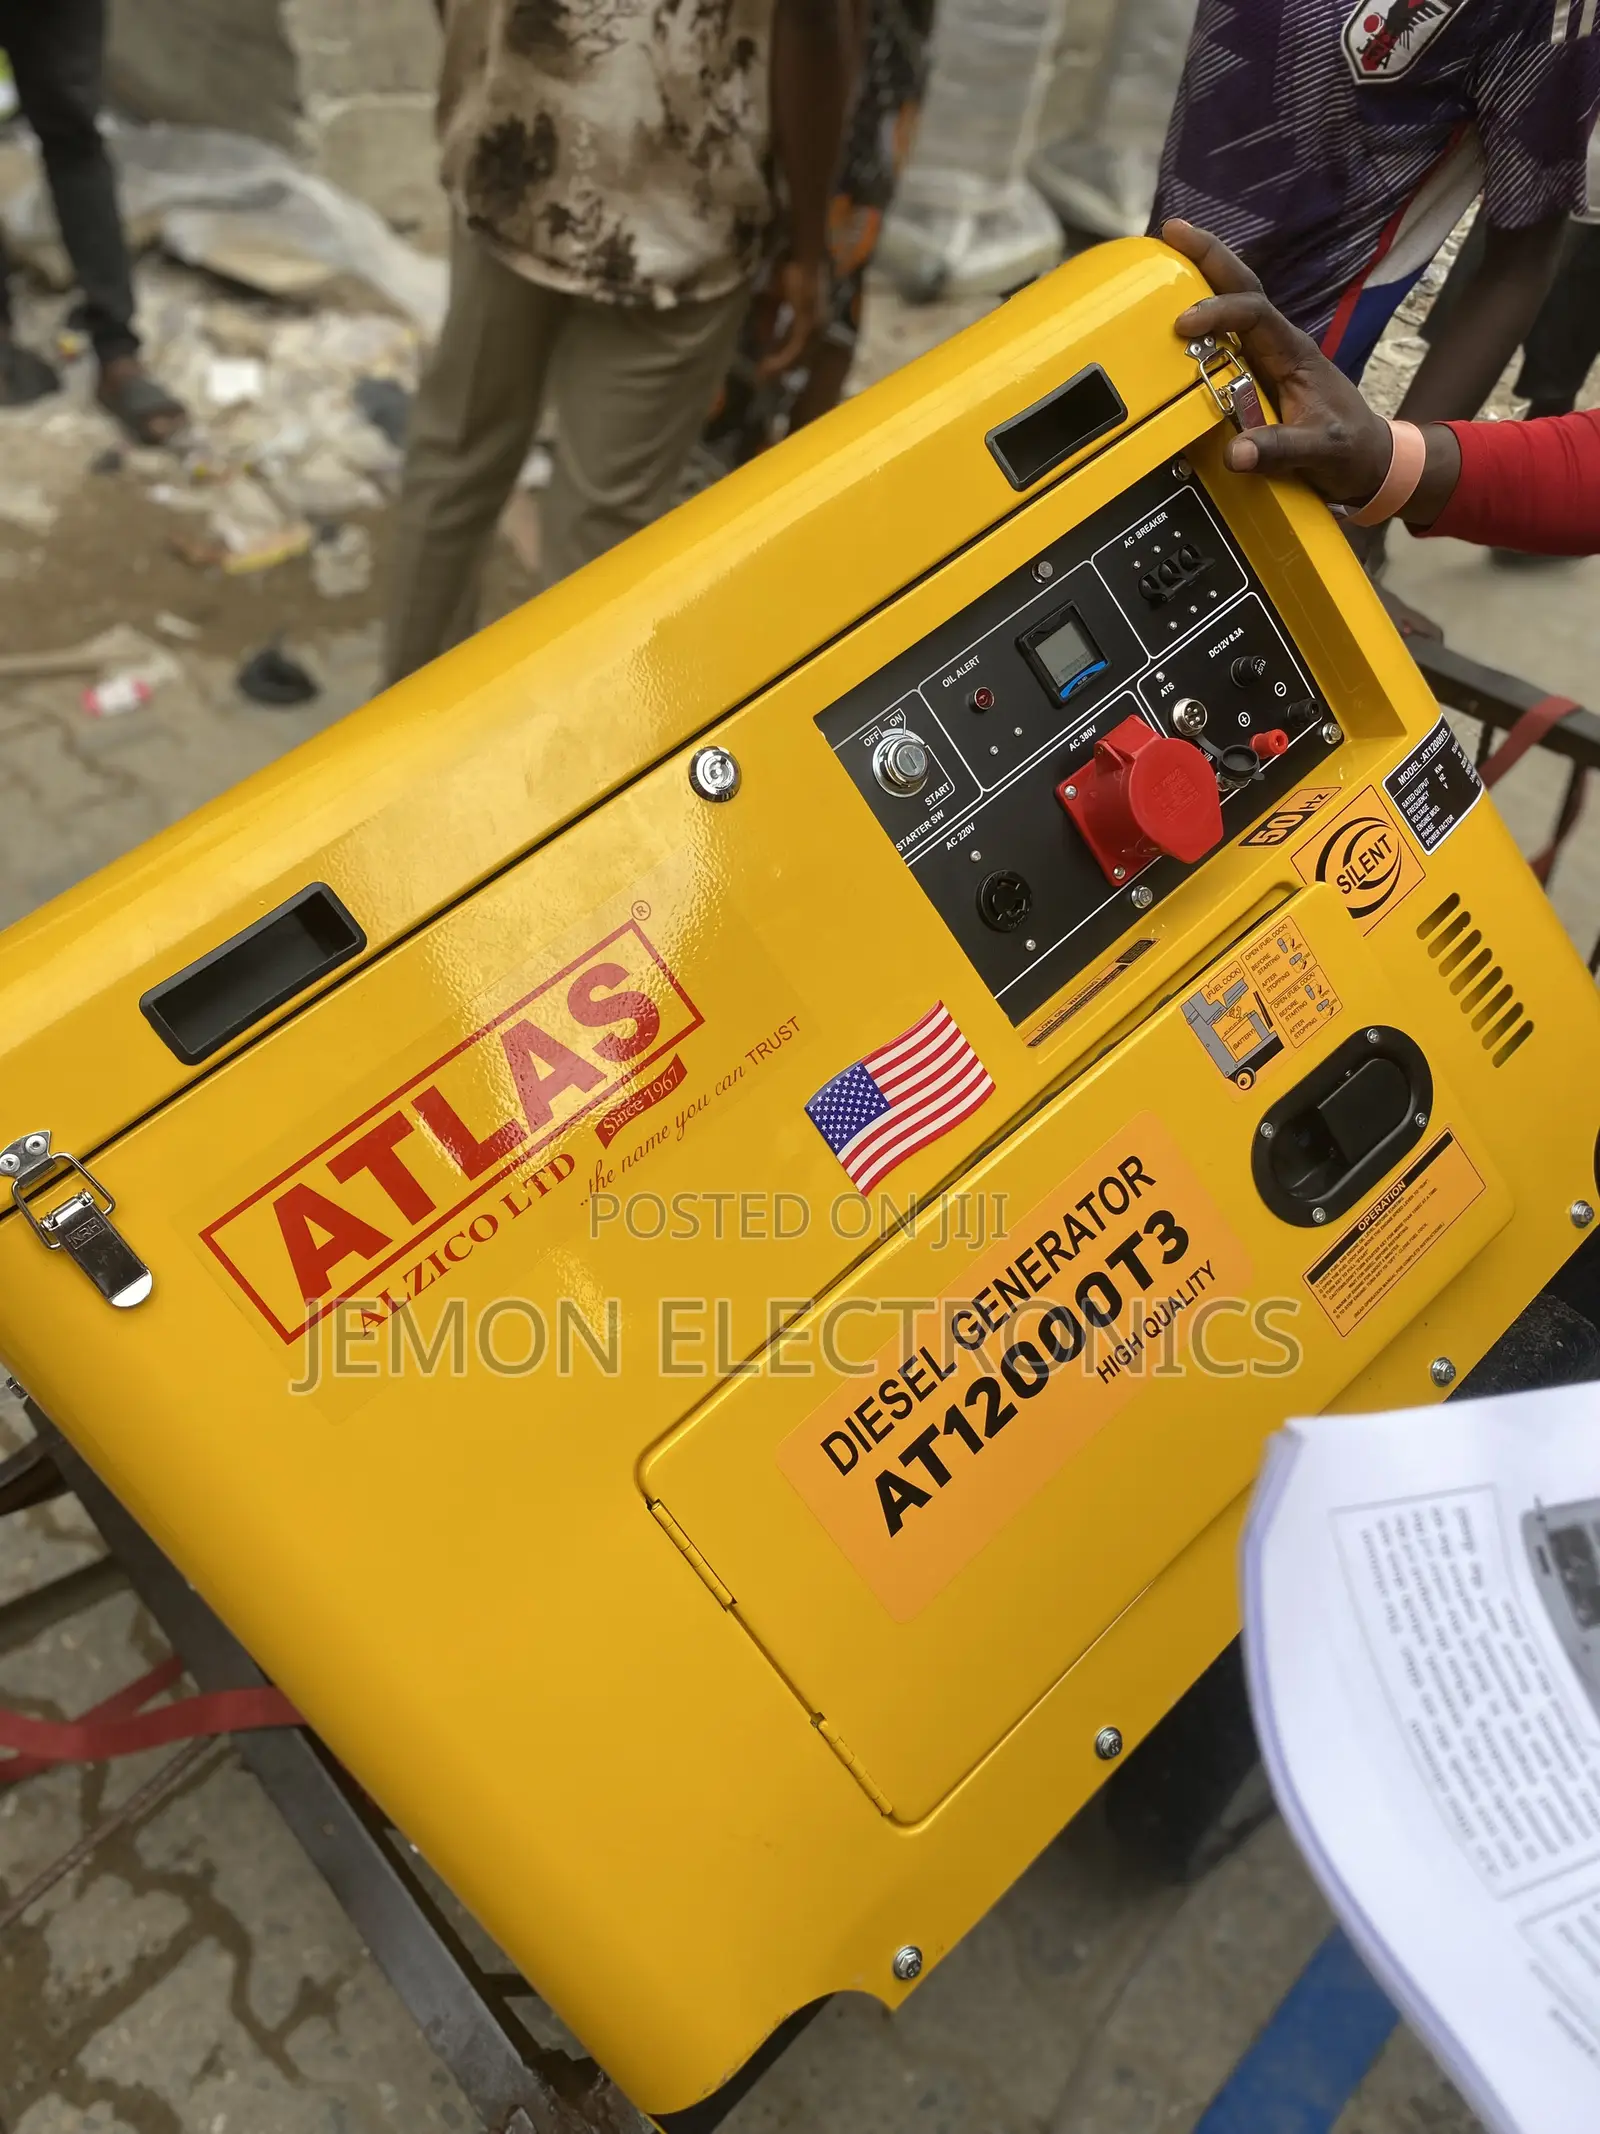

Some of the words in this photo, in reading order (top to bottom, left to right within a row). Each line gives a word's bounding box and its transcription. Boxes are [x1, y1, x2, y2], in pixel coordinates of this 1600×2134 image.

[1123, 536, 1135, 548] AC
[1135, 511, 1168, 539] BREAKER
[1208, 636, 1230, 658] DC12V
[1228, 626, 1244, 642] 8.3A
[942, 675, 957, 688] OIL
[955, 655, 980, 680] ALERT
[1160, 682, 1175, 698] ATS
[889, 713, 904, 728] ON
[863, 730, 881, 748] OFF
[1069, 738, 1080, 752] AC
[1079, 724, 1096, 742] 380V
[1397, 760, 1422, 786] MODEL
[924, 782, 950, 806] START
[1401, 792, 1416, 809] RATED
[1415, 777, 1430, 797] OUTPUT
[1406, 790, 1430, 816] FREQUENCY
[1248, 814, 1304, 844] 50
[1298, 793, 1330, 810] Hz
[1411, 803, 1430, 824] VOLTAGE
[1416, 812, 1432, 832] ENGINE
[895, 820, 932, 852] STARTER
[930, 809, 945, 825] SW
[945, 835, 959, 850] AC
[957, 822, 976, 842] 220V
[1420, 822, 1436, 839] PHASE
[1426, 829, 1442, 847] POWER
[1439, 814, 1455, 832] FACTOR
[1335, 833, 1394, 896] SILENT
[1245, 947, 1259, 960] OPEN
[1250, 952, 1272, 972] BEFORE
[1257, 954, 1281, 976] STARTING
[1206, 982, 1224, 1000] (FUEL
[1222, 967, 1242, 986] COCK)
[1262, 972, 1278, 988] AFTER
[1266, 971, 1290, 994] STOPPING
[1274, 996, 1288, 1009] OPEN
[1279, 999, 1299, 1018] BEFORE
[1284, 1000, 1308, 1022] STARTING
[1289, 1018, 1306, 1034] AFTER
[1294, 1018, 1318, 1040] STOPPING
[602, 1094, 645, 1137] Since
[643, 1066, 680, 1104] 1967
[621, 1124, 670, 1172] name
[675, 1094, 711, 1142] you
[715, 1065, 746, 1096] can
[744, 1016, 801, 1066] TRUST
[272, 962, 660, 1307] ATLAS
[1357, 1180, 1406, 1232] OPERATION
[355, 1213, 500, 1337] ALZICO
[498, 1152, 576, 1222] LTD
[820, 1344, 958, 1476] DIESEL
[950, 1155, 1157, 1353] GENERATOR
[1095, 1331, 1145, 1384] HIGH
[1143, 1259, 1217, 1341] QUALITY
[874, 1209, 1190, 1538] AT12000T3
